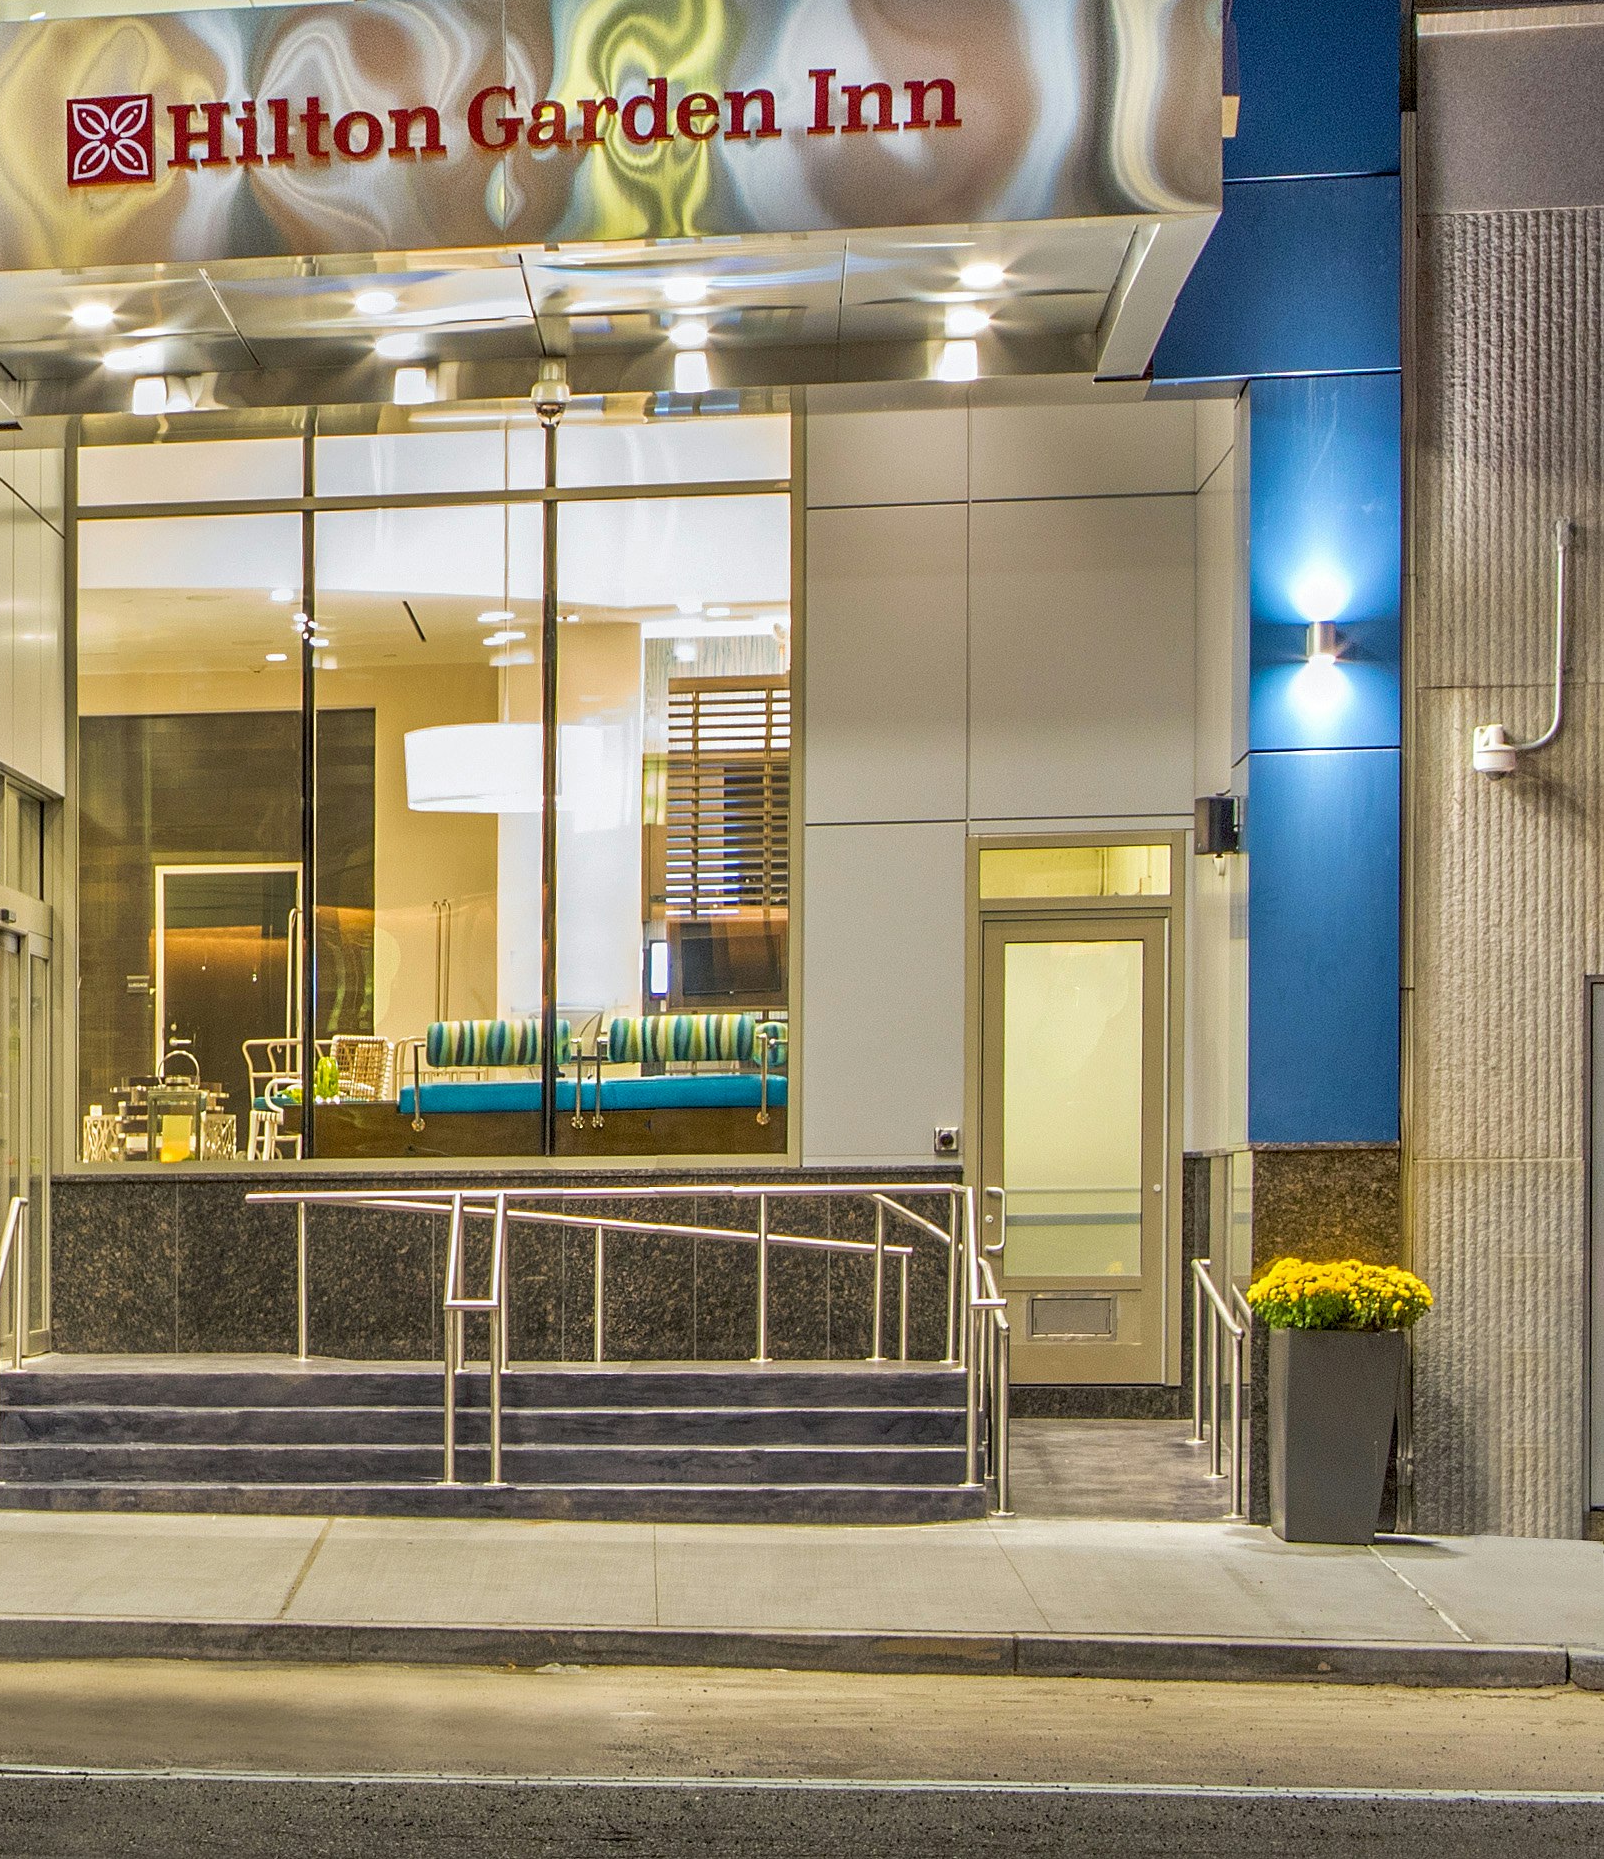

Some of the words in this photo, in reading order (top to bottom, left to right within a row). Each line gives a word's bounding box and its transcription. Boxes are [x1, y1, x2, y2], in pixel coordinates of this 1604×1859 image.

[166, 97, 448, 169] Hilton
[466, 76, 782, 155] Garden
[806, 67, 963, 136] Inn
